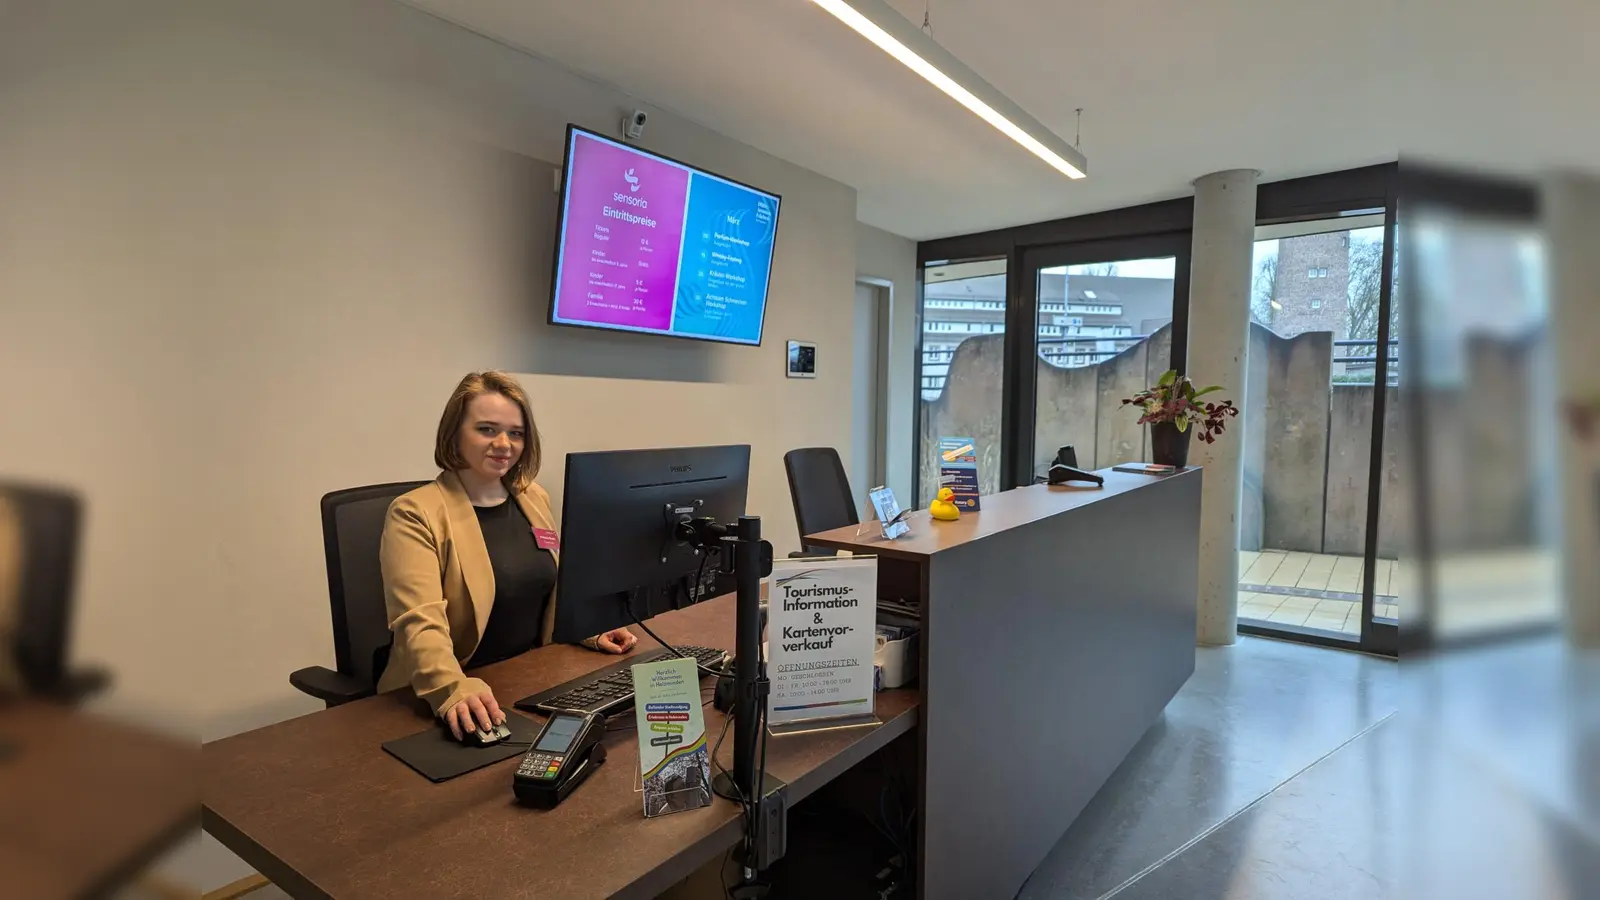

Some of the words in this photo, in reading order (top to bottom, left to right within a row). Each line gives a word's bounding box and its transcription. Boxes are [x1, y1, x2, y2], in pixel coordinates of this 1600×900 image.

[613, 192, 648, 209] sensoria
[603, 206, 657, 228] Eintrittspreise
[783, 584, 853, 599] Tourismus-
[783, 596, 858, 611] Information
[813, 612, 823, 624] &
[782, 624, 854, 639] Kartenvor-
[782, 636, 834, 652] verkauf
[651, 674, 682, 682] Willkommen
[656, 668, 677, 676] Herzlich
